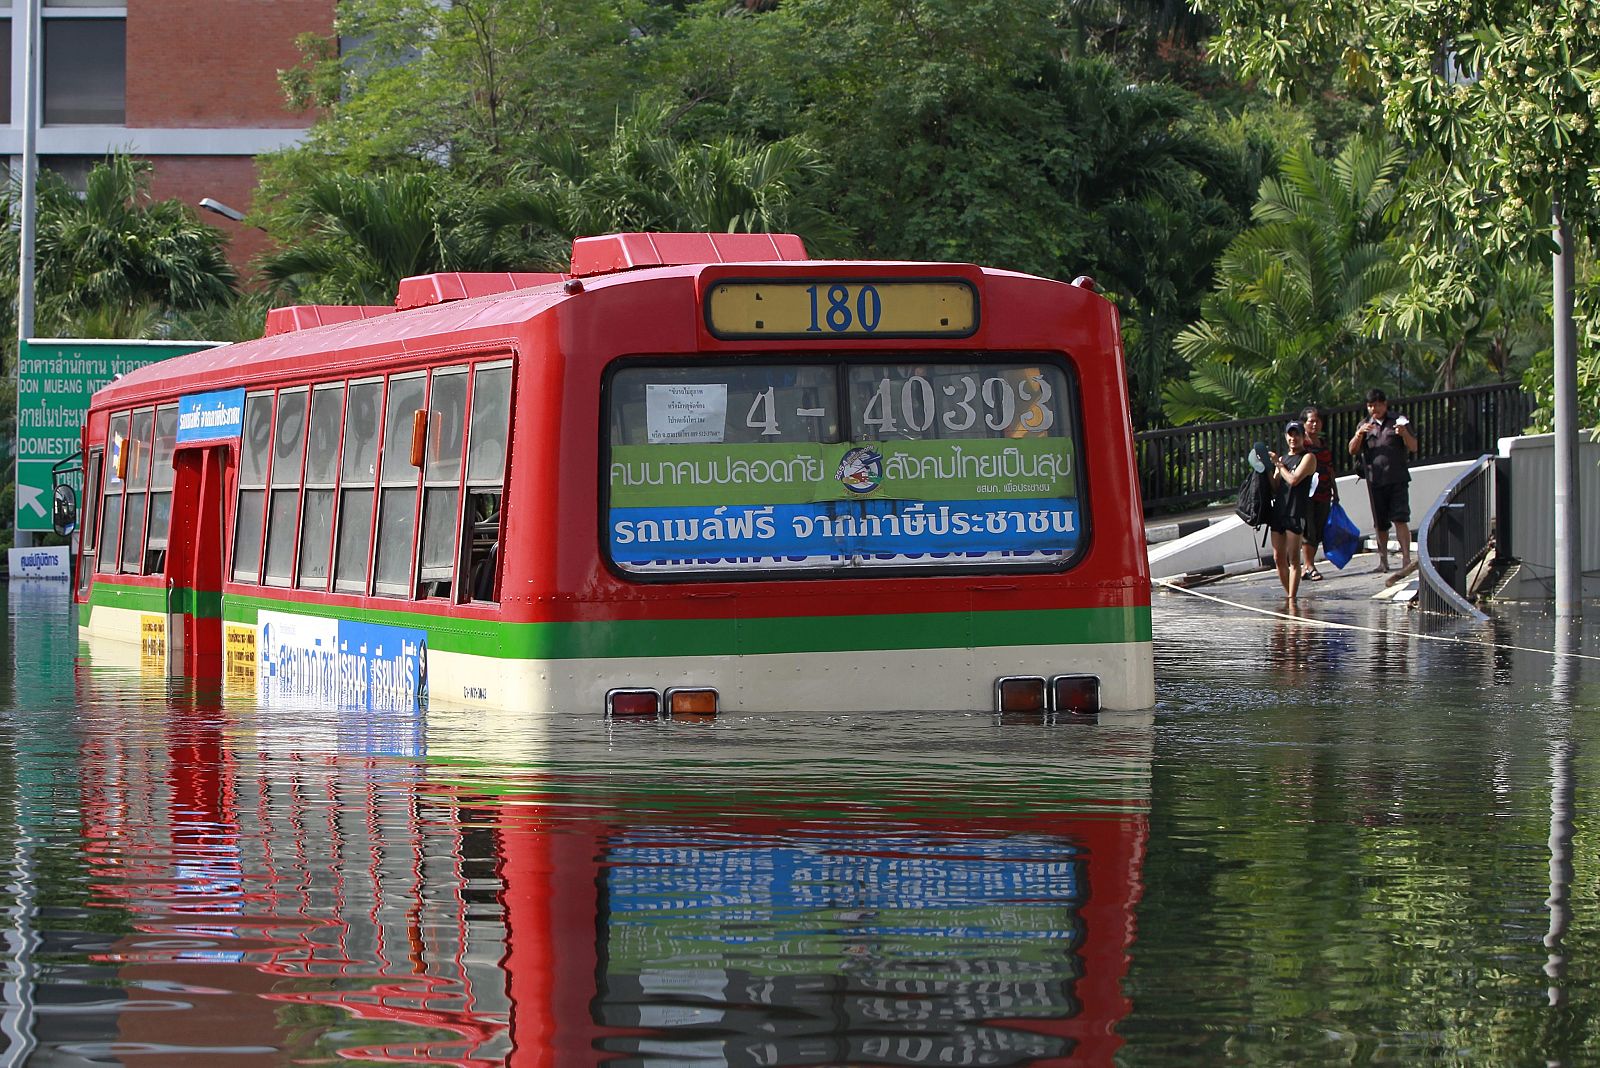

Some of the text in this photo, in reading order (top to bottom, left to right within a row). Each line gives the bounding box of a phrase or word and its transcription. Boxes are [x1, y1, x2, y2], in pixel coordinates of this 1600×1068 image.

[805, 284, 882, 332] 180
[20, 351, 107, 374] อาคารสำนักงาน
[20, 380, 39, 393] DON
[44, 380, 82, 393] MUEANG
[863, 374, 1054, 433] 40393
[610, 455, 825, 486] คมนาคมปลอดภัย
[885, 446, 1072, 483] สังคมไทยเป็นสุข
[1004, 480, 1050, 493] เพื่อประชาชน
[614, 503, 1075, 544] รถเมล์ฟรี จากภาษีประชาชน
